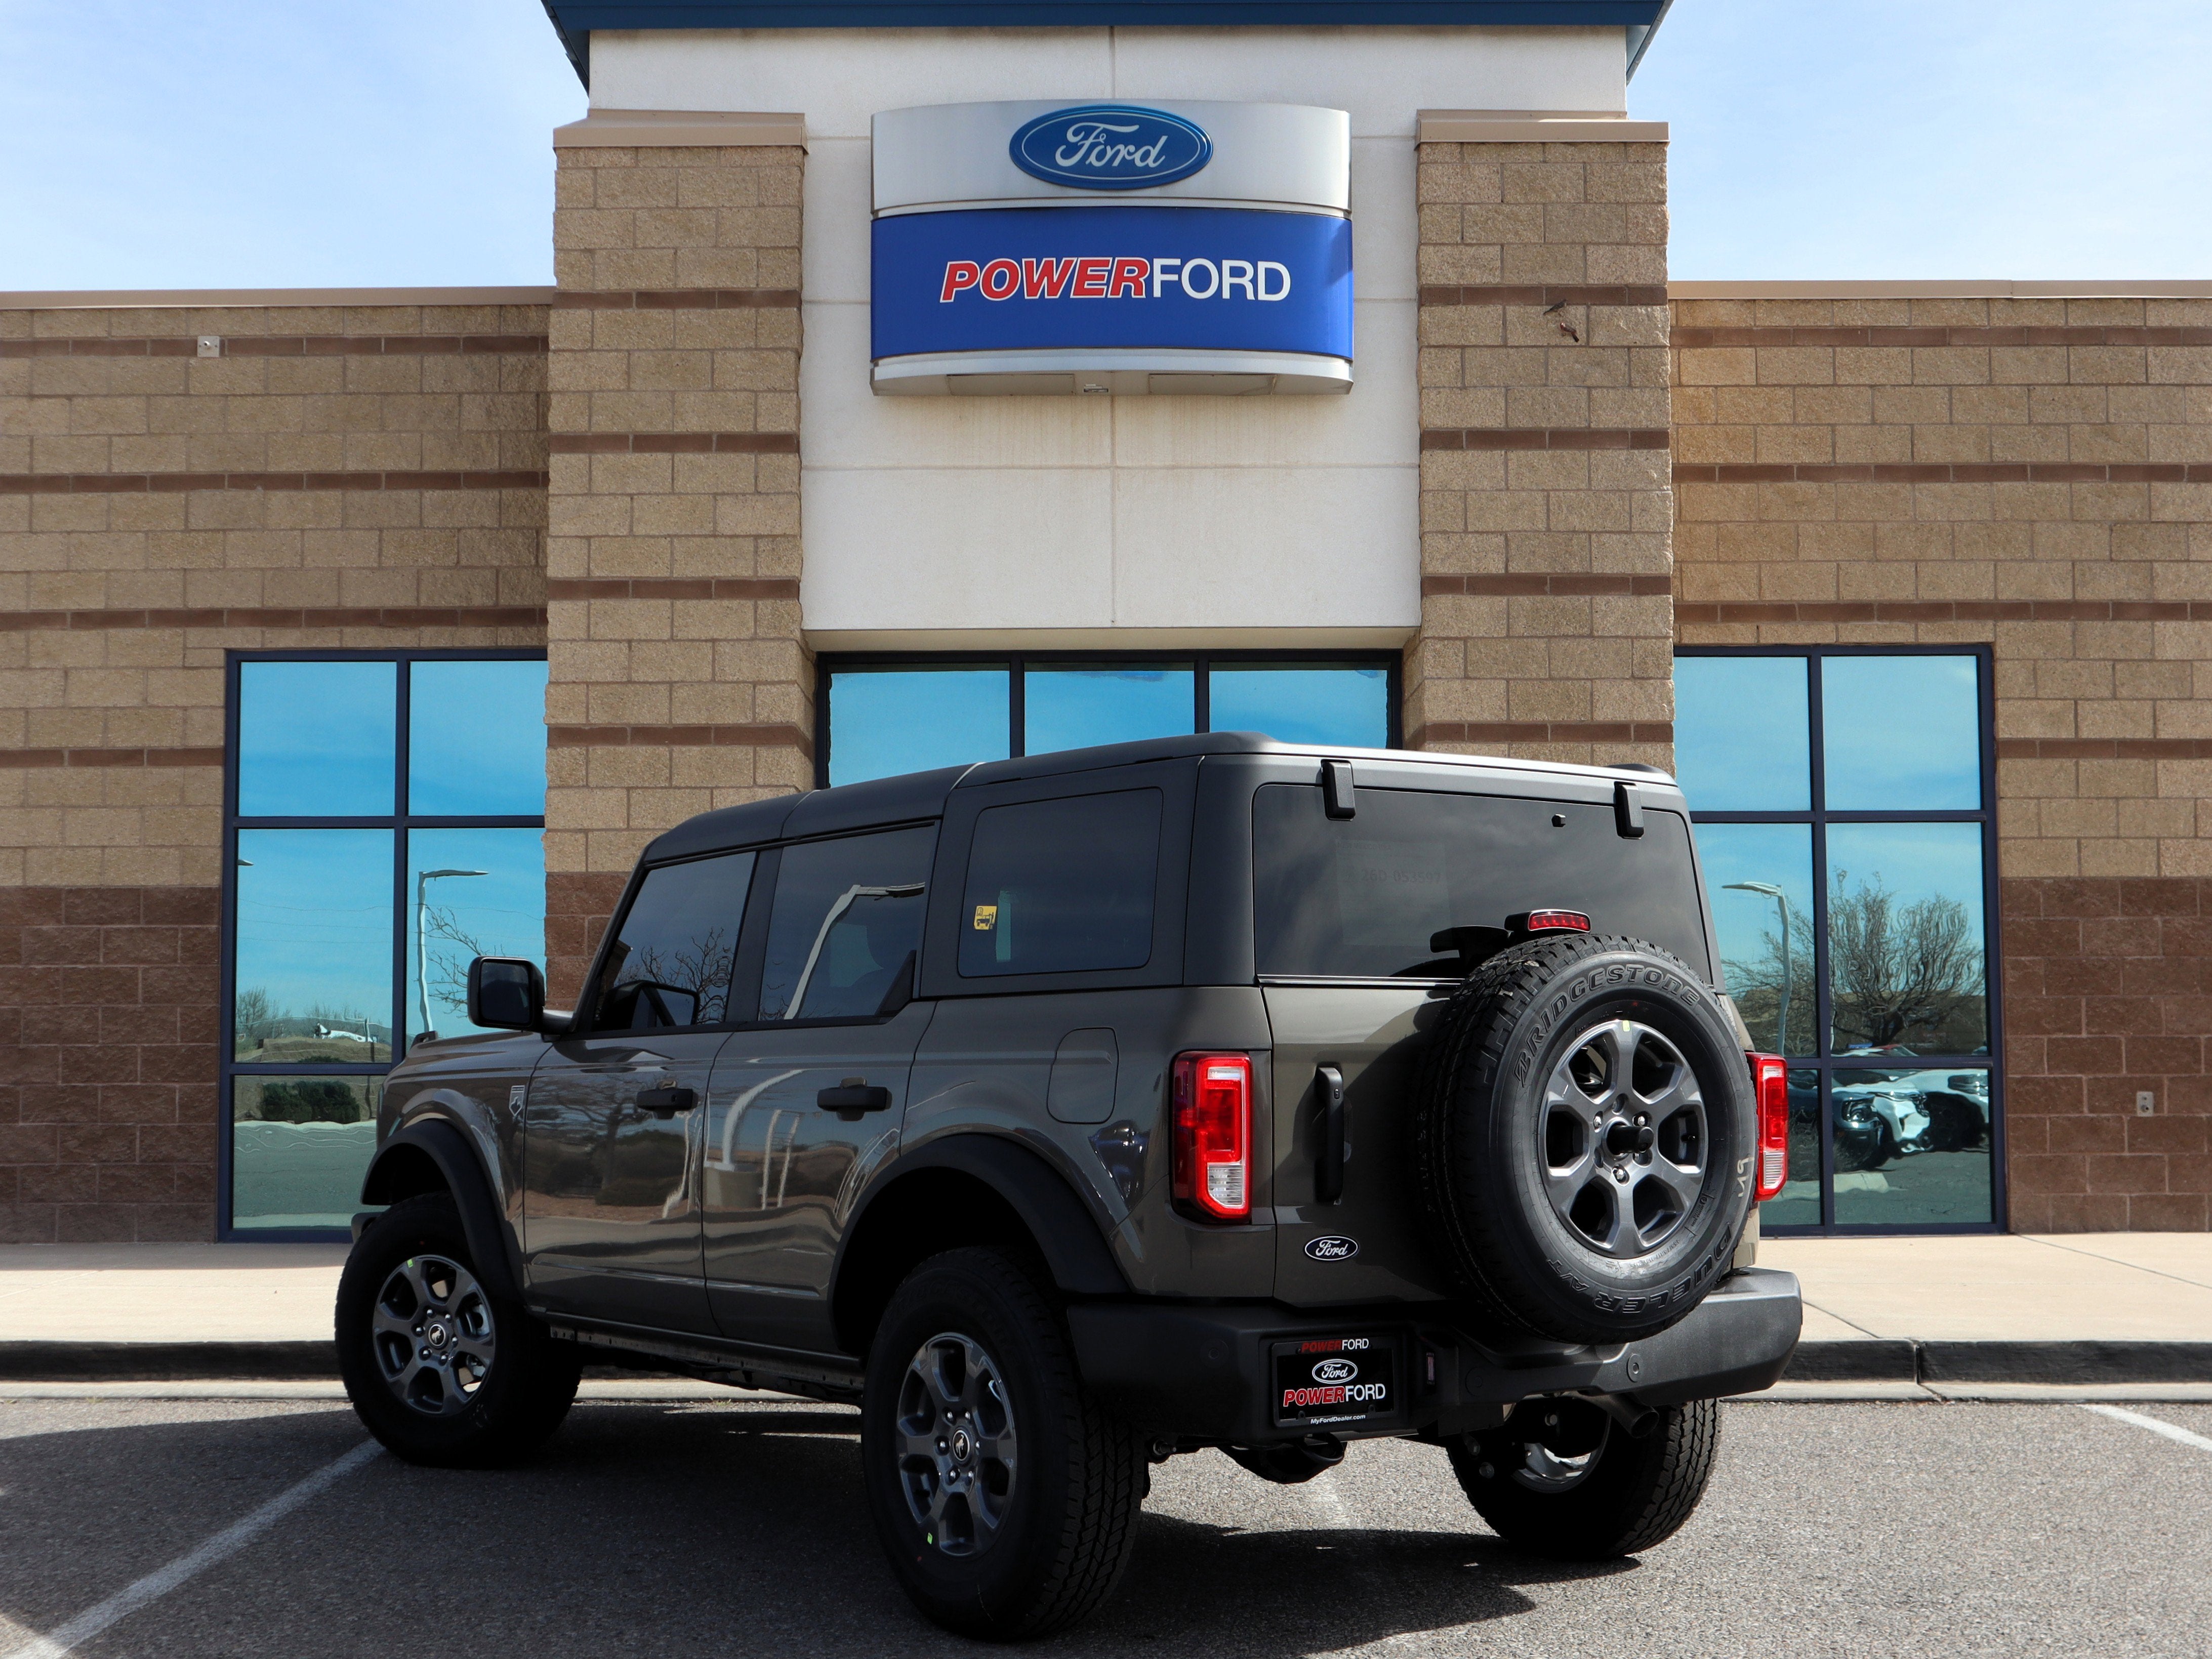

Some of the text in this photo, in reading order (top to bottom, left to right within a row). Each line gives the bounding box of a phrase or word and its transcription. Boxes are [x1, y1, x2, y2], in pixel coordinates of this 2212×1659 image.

[1055, 122, 1167, 168] Ford
[1514, 964, 1700, 1086] BRIDGESTONE
[1316, 1239, 1348, 1256] Ford
[1548, 1222, 1732, 1314] DUELER A/T
[1322, 1364, 1347, 1378] Ford
[1310, 1415, 1365, 1424] MyFordDealer.com
